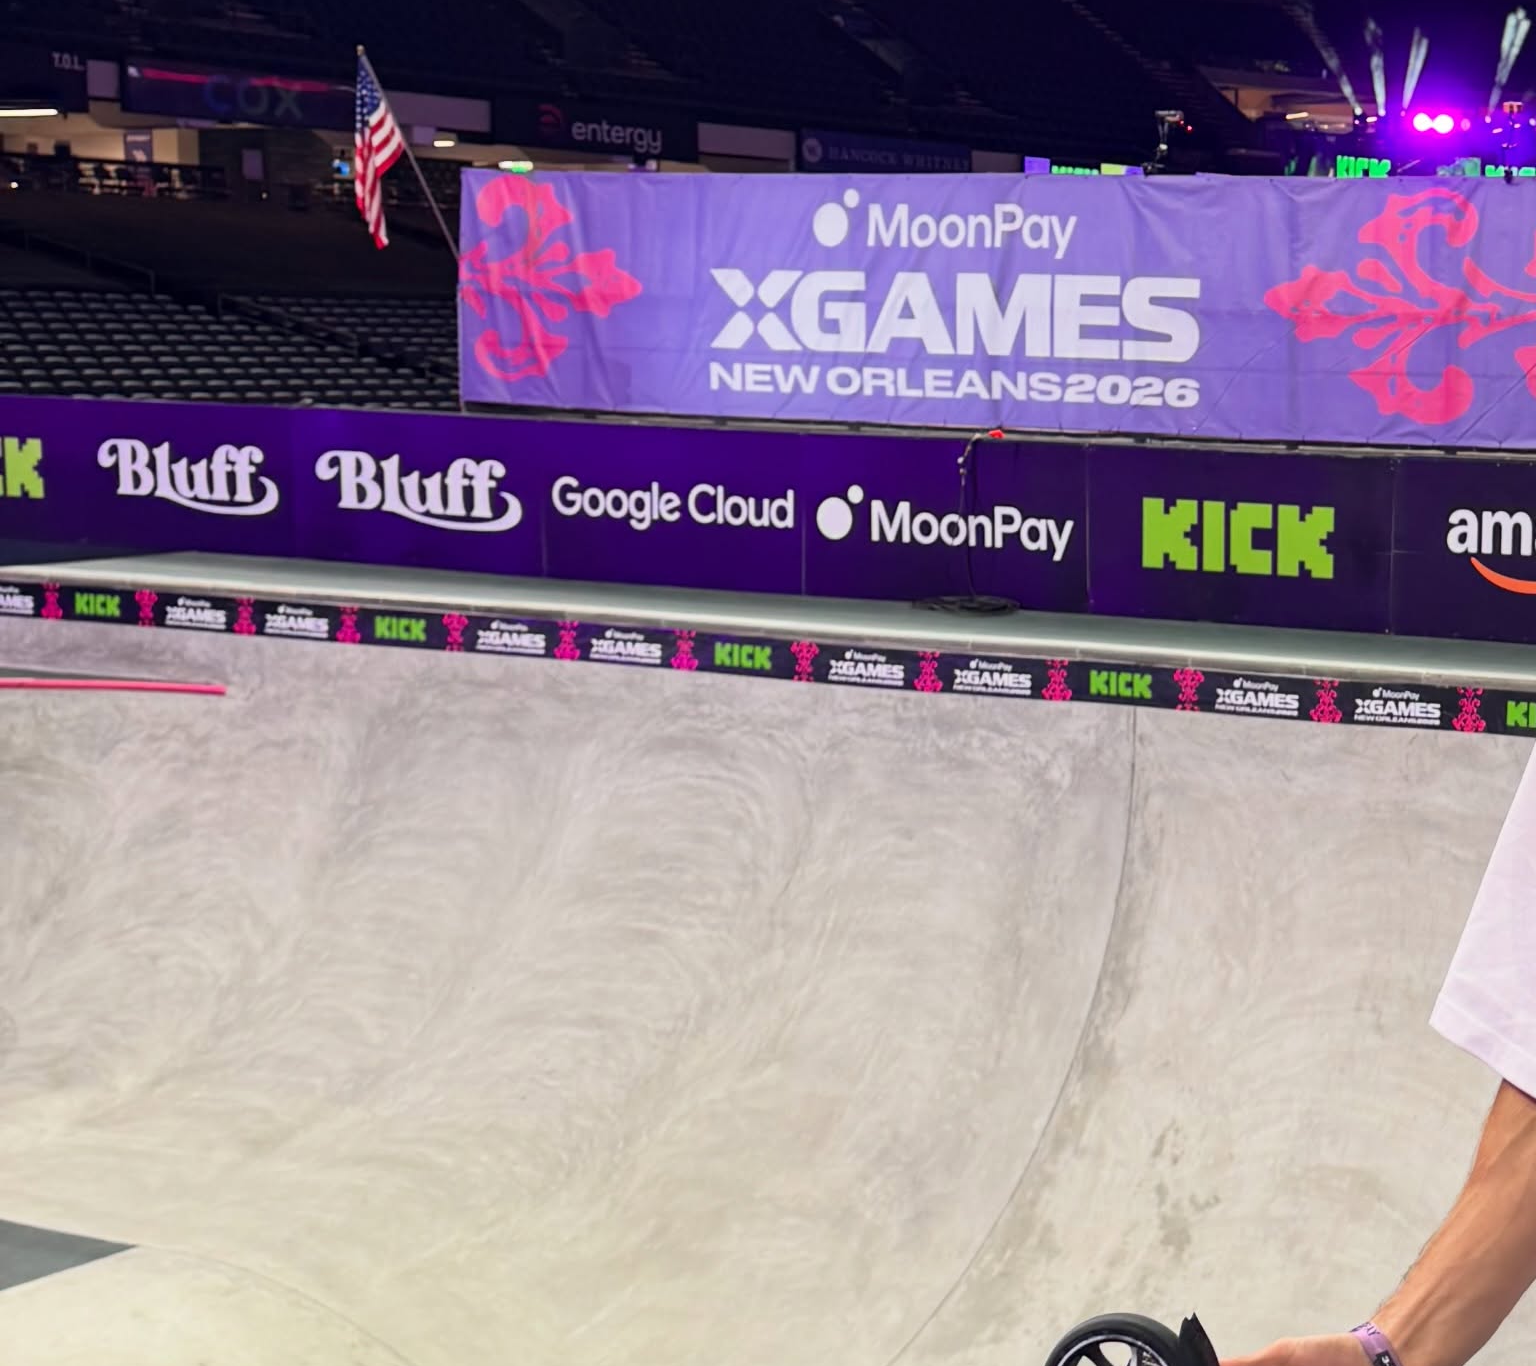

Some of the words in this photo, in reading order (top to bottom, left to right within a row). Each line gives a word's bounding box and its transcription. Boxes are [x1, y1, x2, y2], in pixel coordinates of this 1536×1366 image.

[571, 119, 662, 154] entergy
[866, 202, 1078, 259] MoonPay
[709, 267, 1201, 363] XGAMES
[709, 361, 821, 394] NEW
[97, 437, 280, 516] Bluff
[314, 449, 523, 533] Bluff
[551, 475, 681, 531] Google
[686, 481, 796, 531] Cloud
[869, 499, 1075, 562] MoonPay
[1142, 497, 1335, 579] KICK
[74, 592, 121, 618] KICK
[374, 615, 427, 642] KICK
[714, 642, 773, 671] KICK
[829, 659, 905, 680] XGAMES
[953, 669, 1033, 689] XGAMES
[1089, 669, 1153, 700] KICK
[1215, 688, 1299, 710] XGAMES
[1354, 698, 1441, 719] XGAMES
